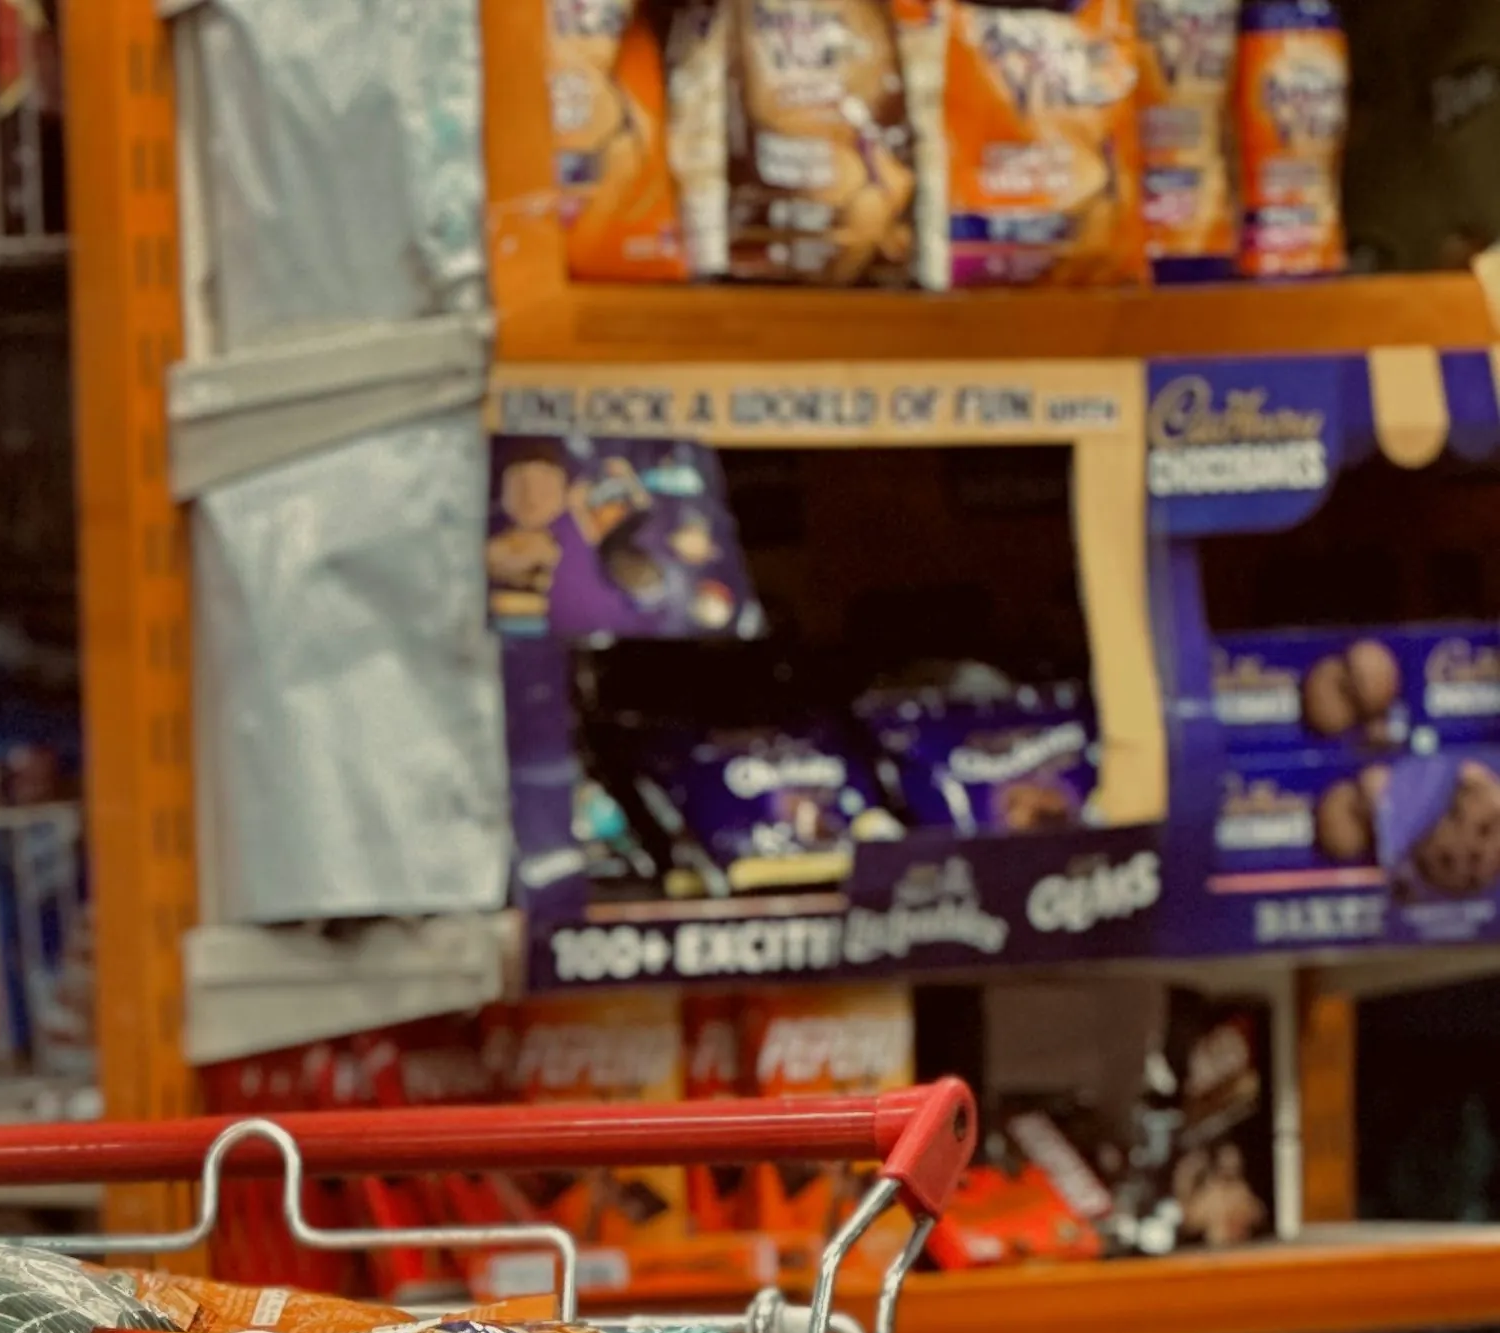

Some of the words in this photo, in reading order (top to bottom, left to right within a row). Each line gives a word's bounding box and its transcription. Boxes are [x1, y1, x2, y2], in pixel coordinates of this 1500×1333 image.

[689, 388, 713, 424] A
[731, 384, 879, 428] WORLD
[952, 384, 1032, 423] FUN
